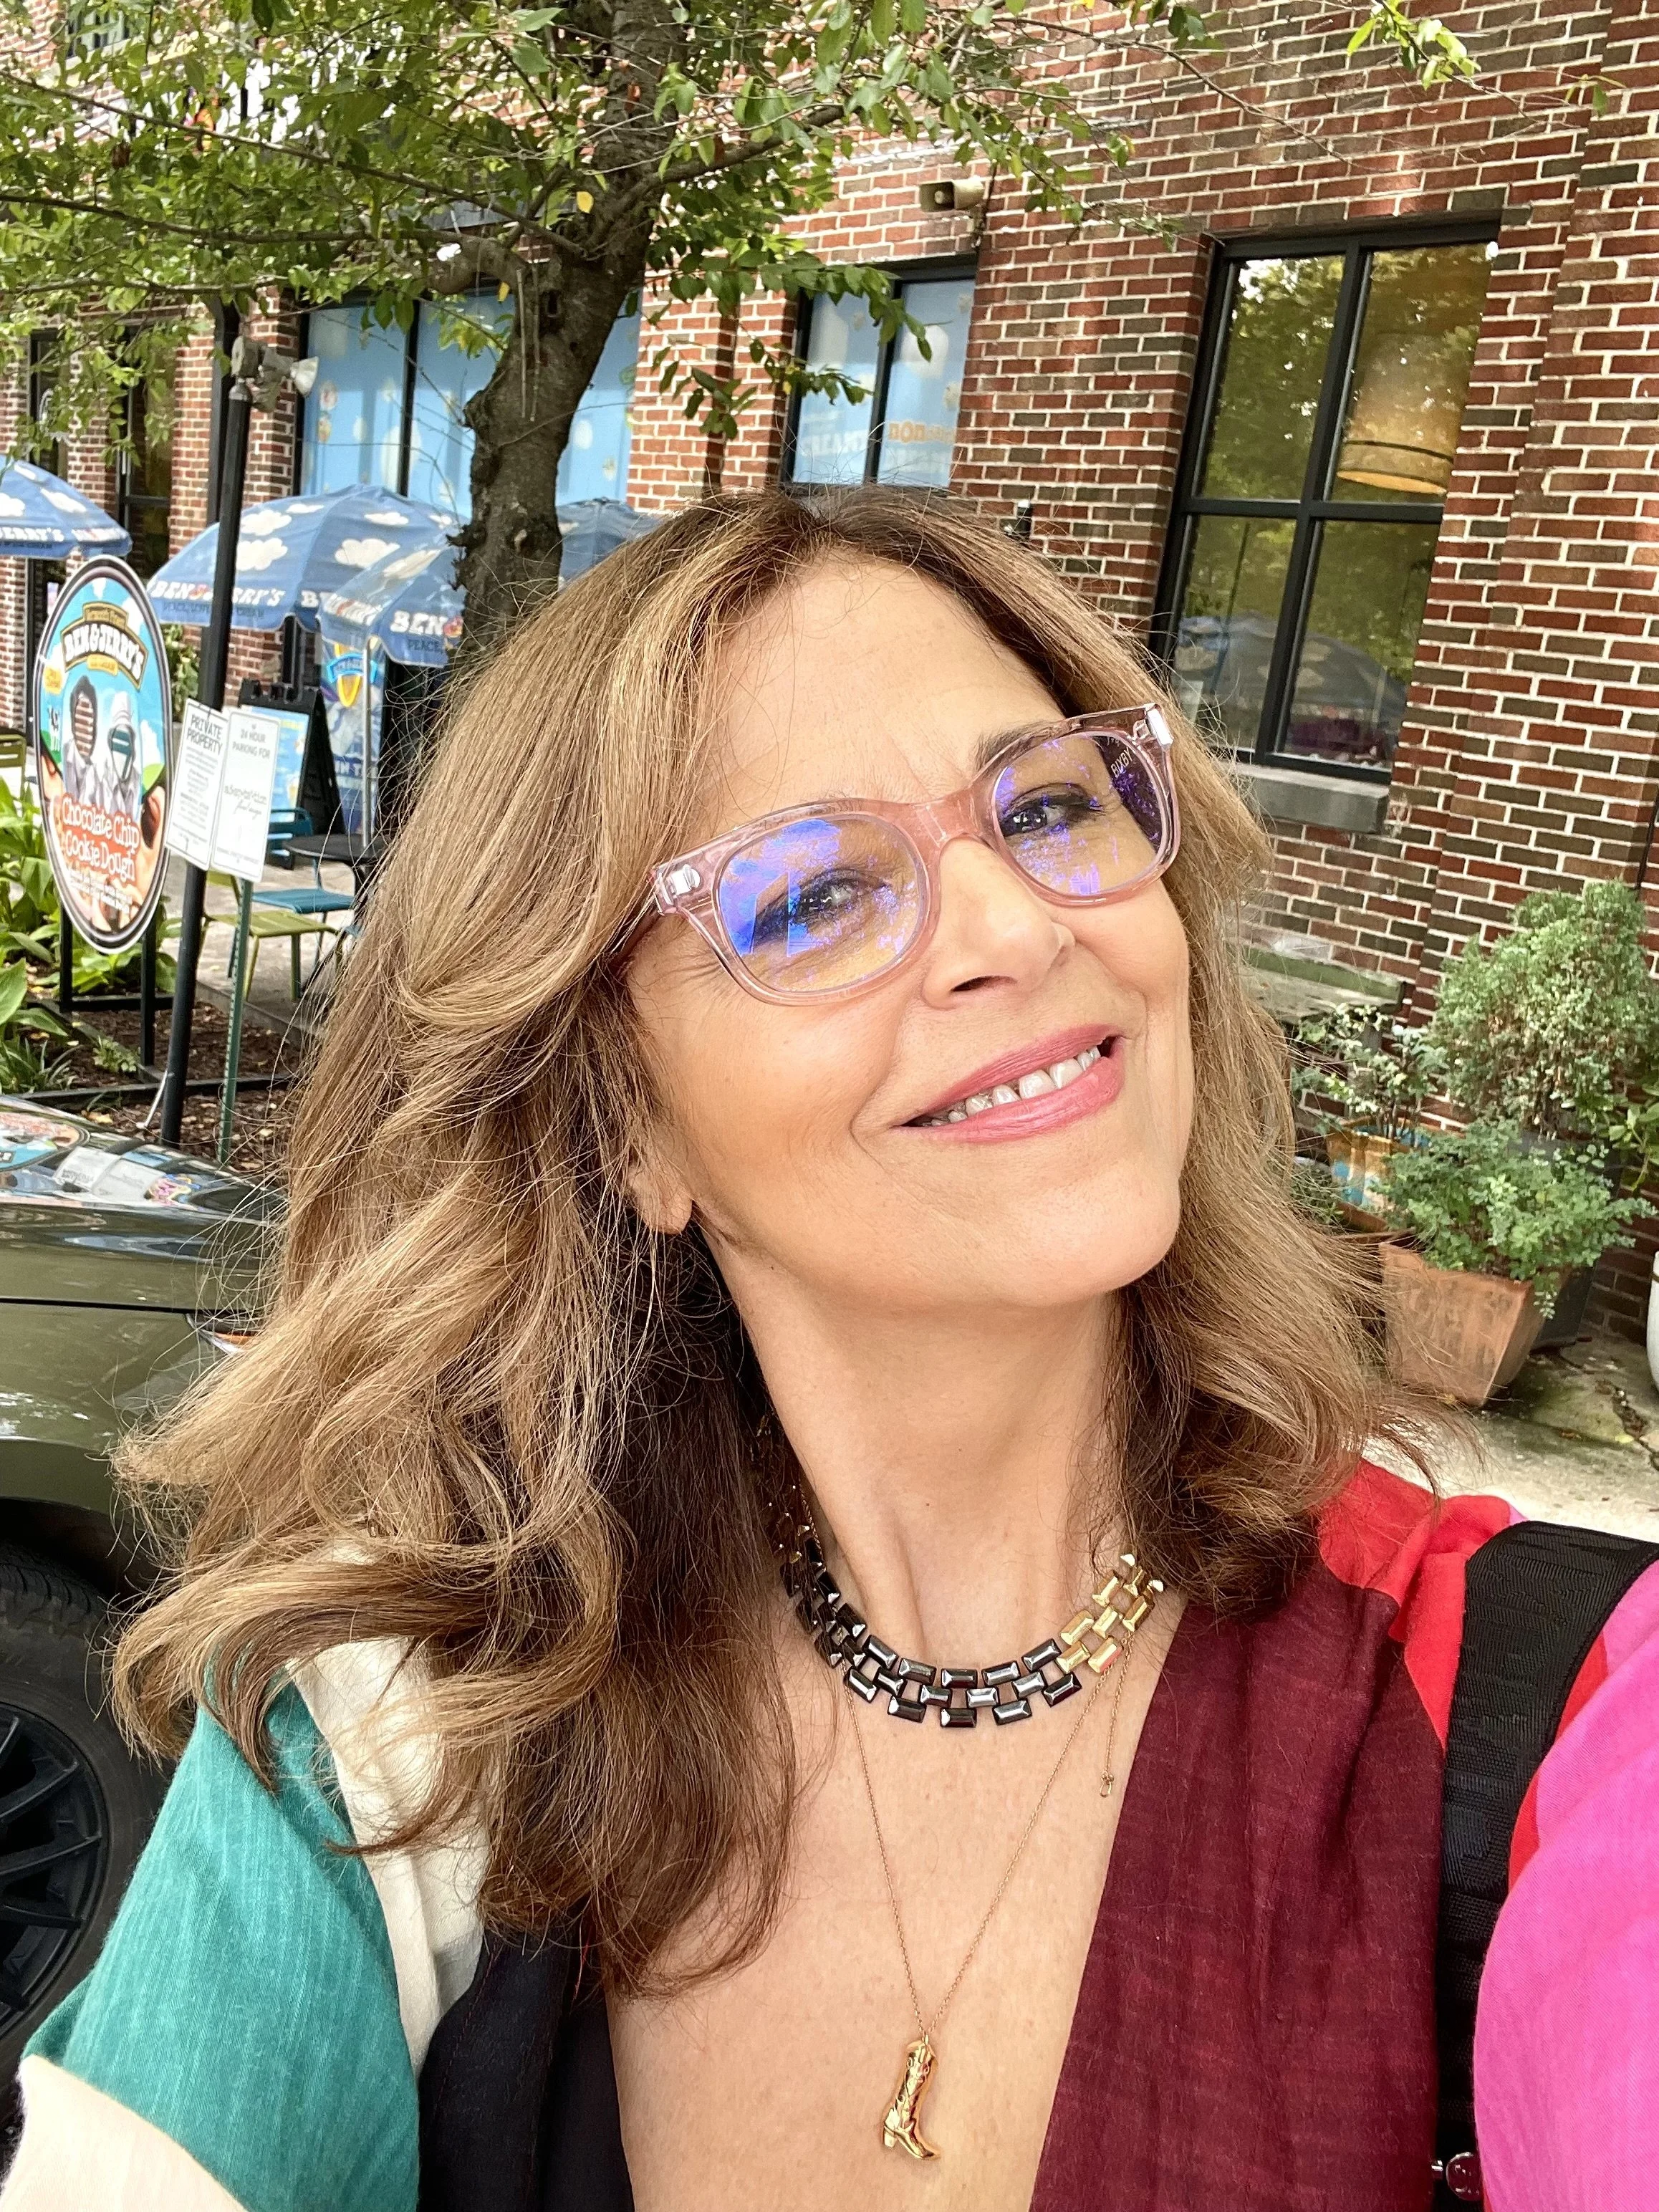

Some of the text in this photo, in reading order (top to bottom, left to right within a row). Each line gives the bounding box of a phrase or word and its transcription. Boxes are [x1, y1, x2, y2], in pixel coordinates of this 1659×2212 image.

[0, 526, 65, 542] ERRY'S
[191, 713, 223, 740] PRIVATE
[240, 729, 266, 744] 24 HOUR
[186, 727, 223, 756] PROPERTY
[232, 741, 271, 760] PARKING FOR
[62, 796, 114, 840] Chocolate
[113, 815, 140, 855] Chip
[65, 830, 135, 883] Cookie Dough
